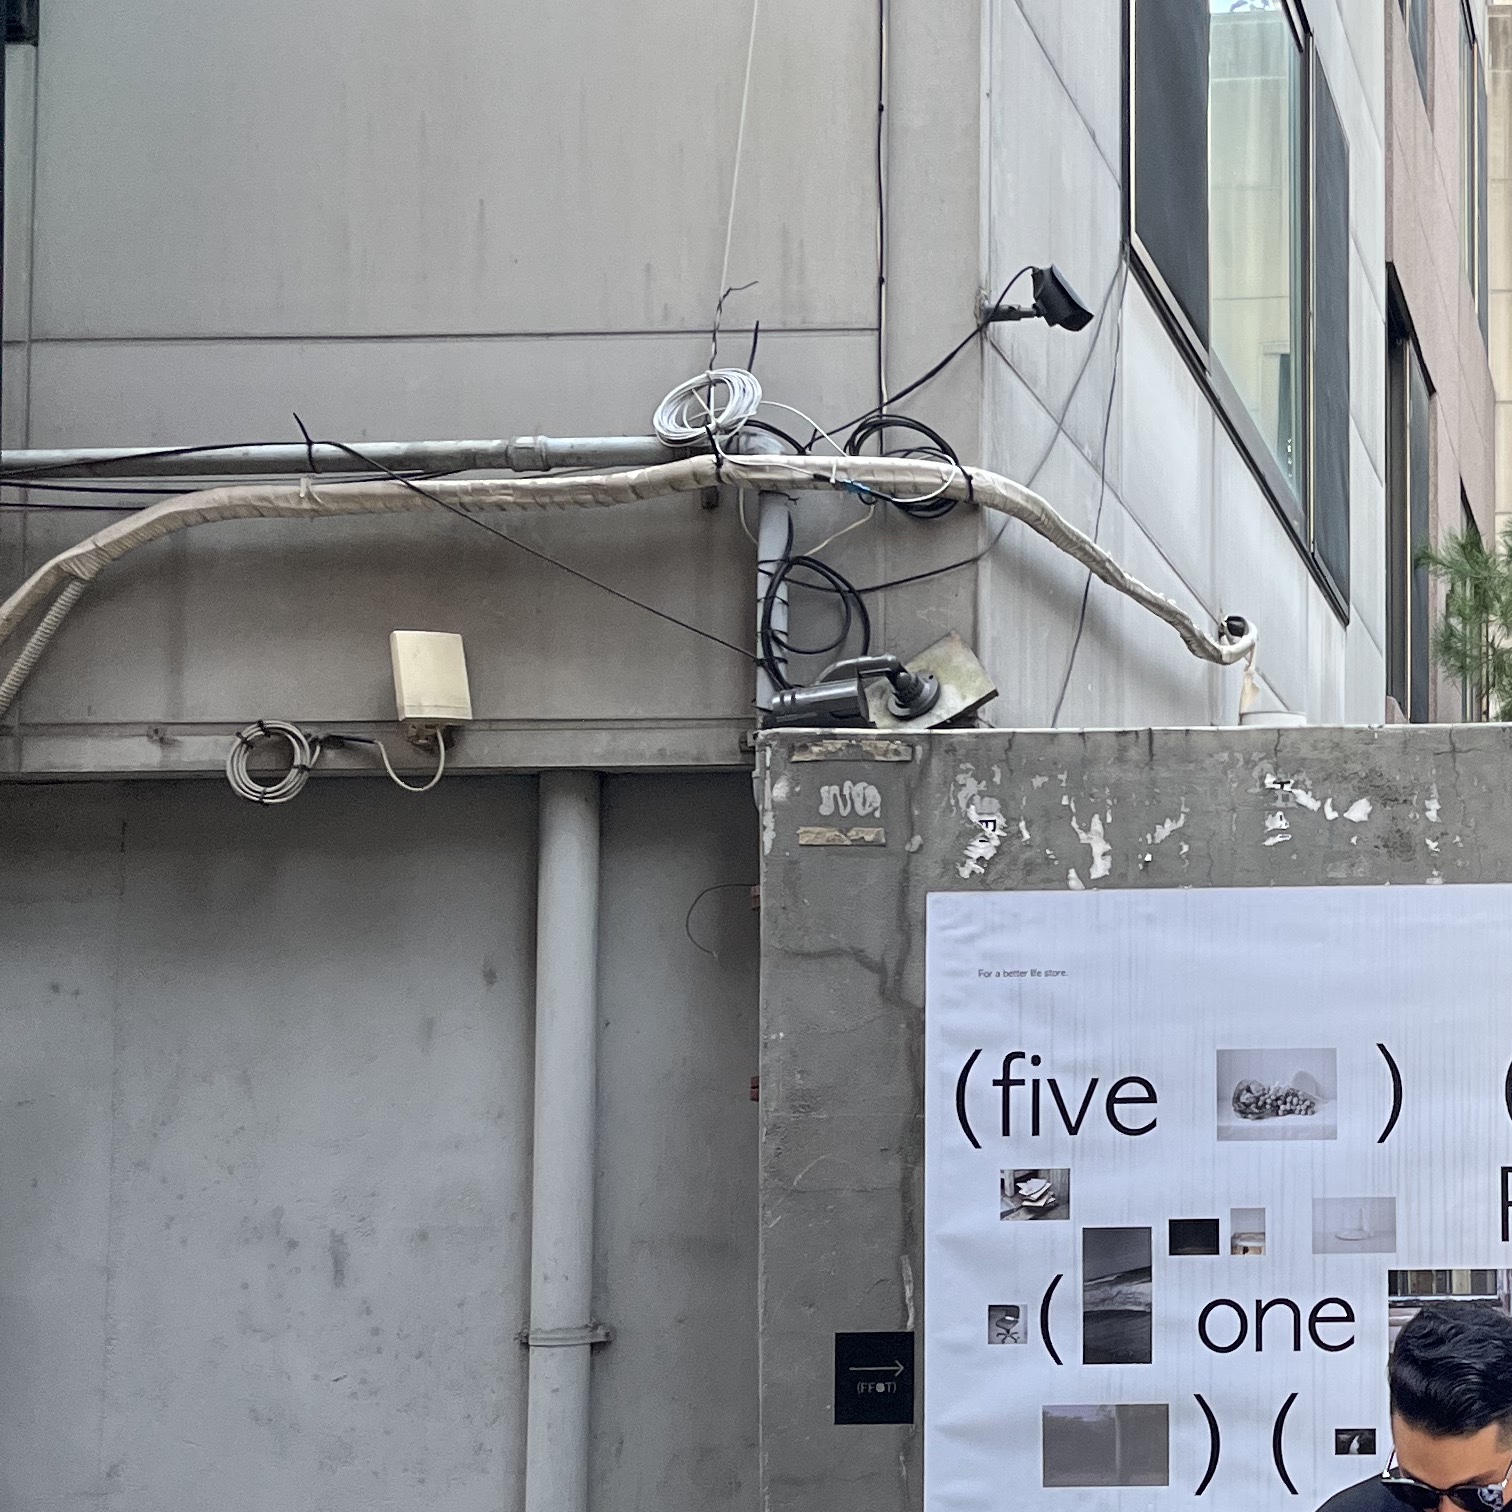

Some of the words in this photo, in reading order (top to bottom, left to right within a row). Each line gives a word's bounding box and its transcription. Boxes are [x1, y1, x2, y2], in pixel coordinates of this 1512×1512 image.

[978, 968, 992, 978] For
[995, 970, 1000, 978] a
[1003, 968, 1027, 978] better
[1030, 968, 1042, 978] life
[1198, 1297, 1356, 1354] one
